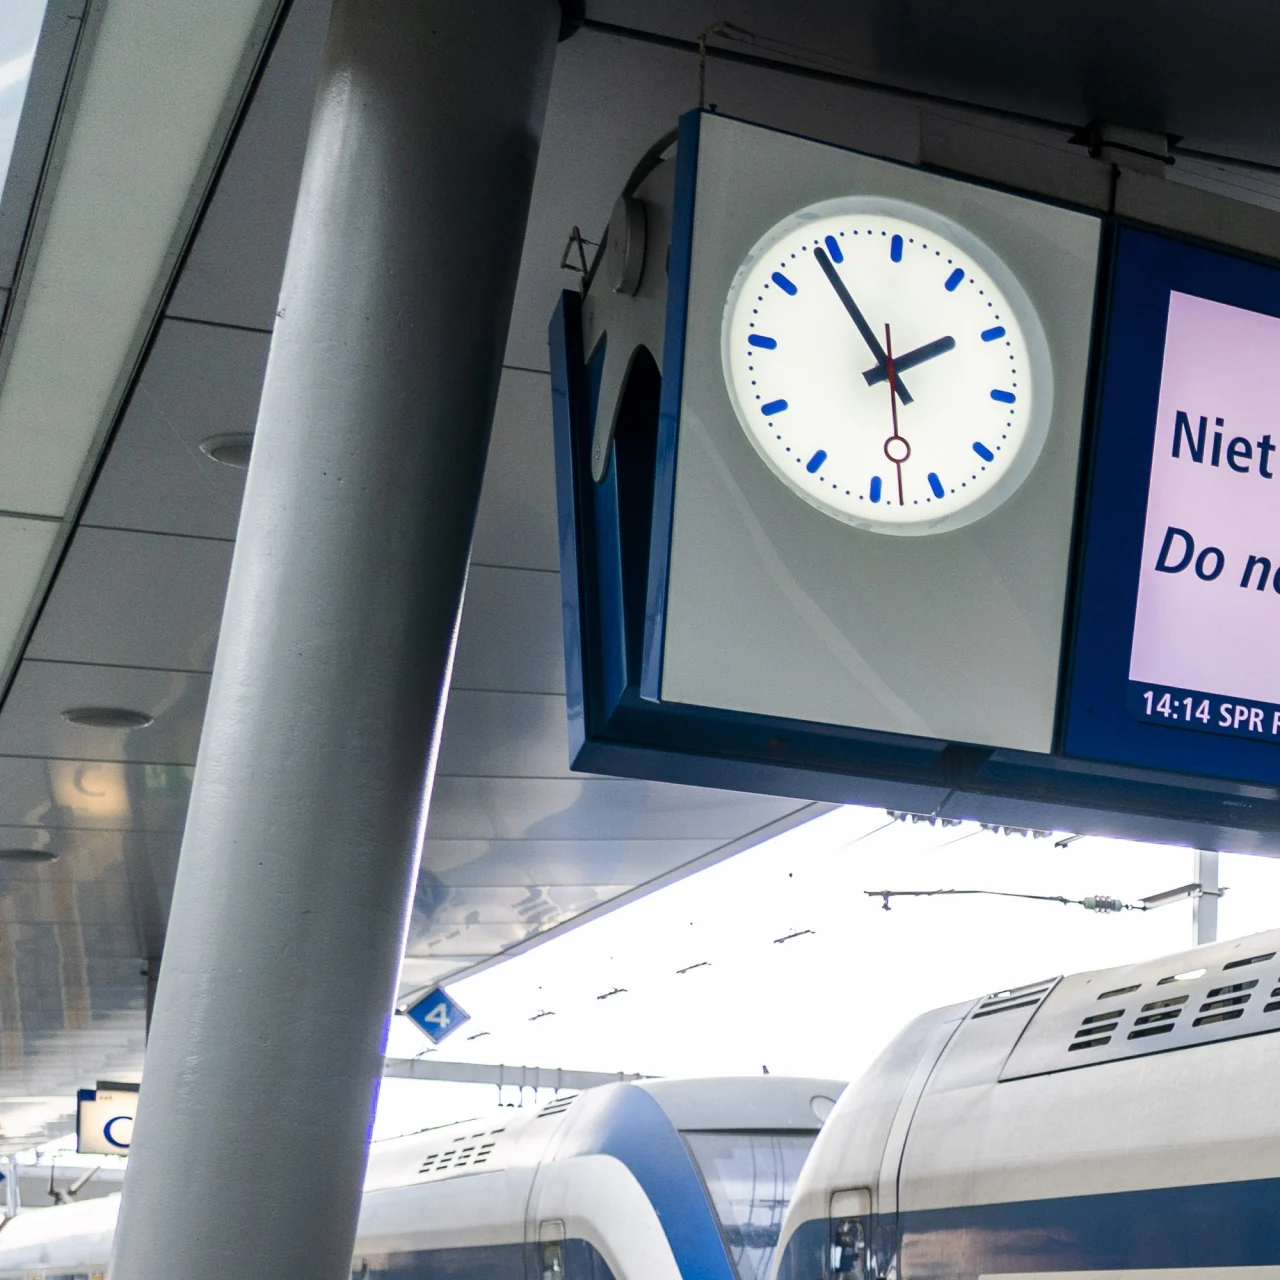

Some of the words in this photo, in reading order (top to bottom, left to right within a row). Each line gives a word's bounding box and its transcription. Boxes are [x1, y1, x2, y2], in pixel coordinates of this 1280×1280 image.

[1171, 410, 1276, 479] Niet
[1154, 526, 1226, 582] Do
[1143, 690, 1211, 724] 14:14
[1218, 703, 1265, 733] SPR
[424, 1002, 450, 1028] 4
[103, 1116, 133, 1149] C
